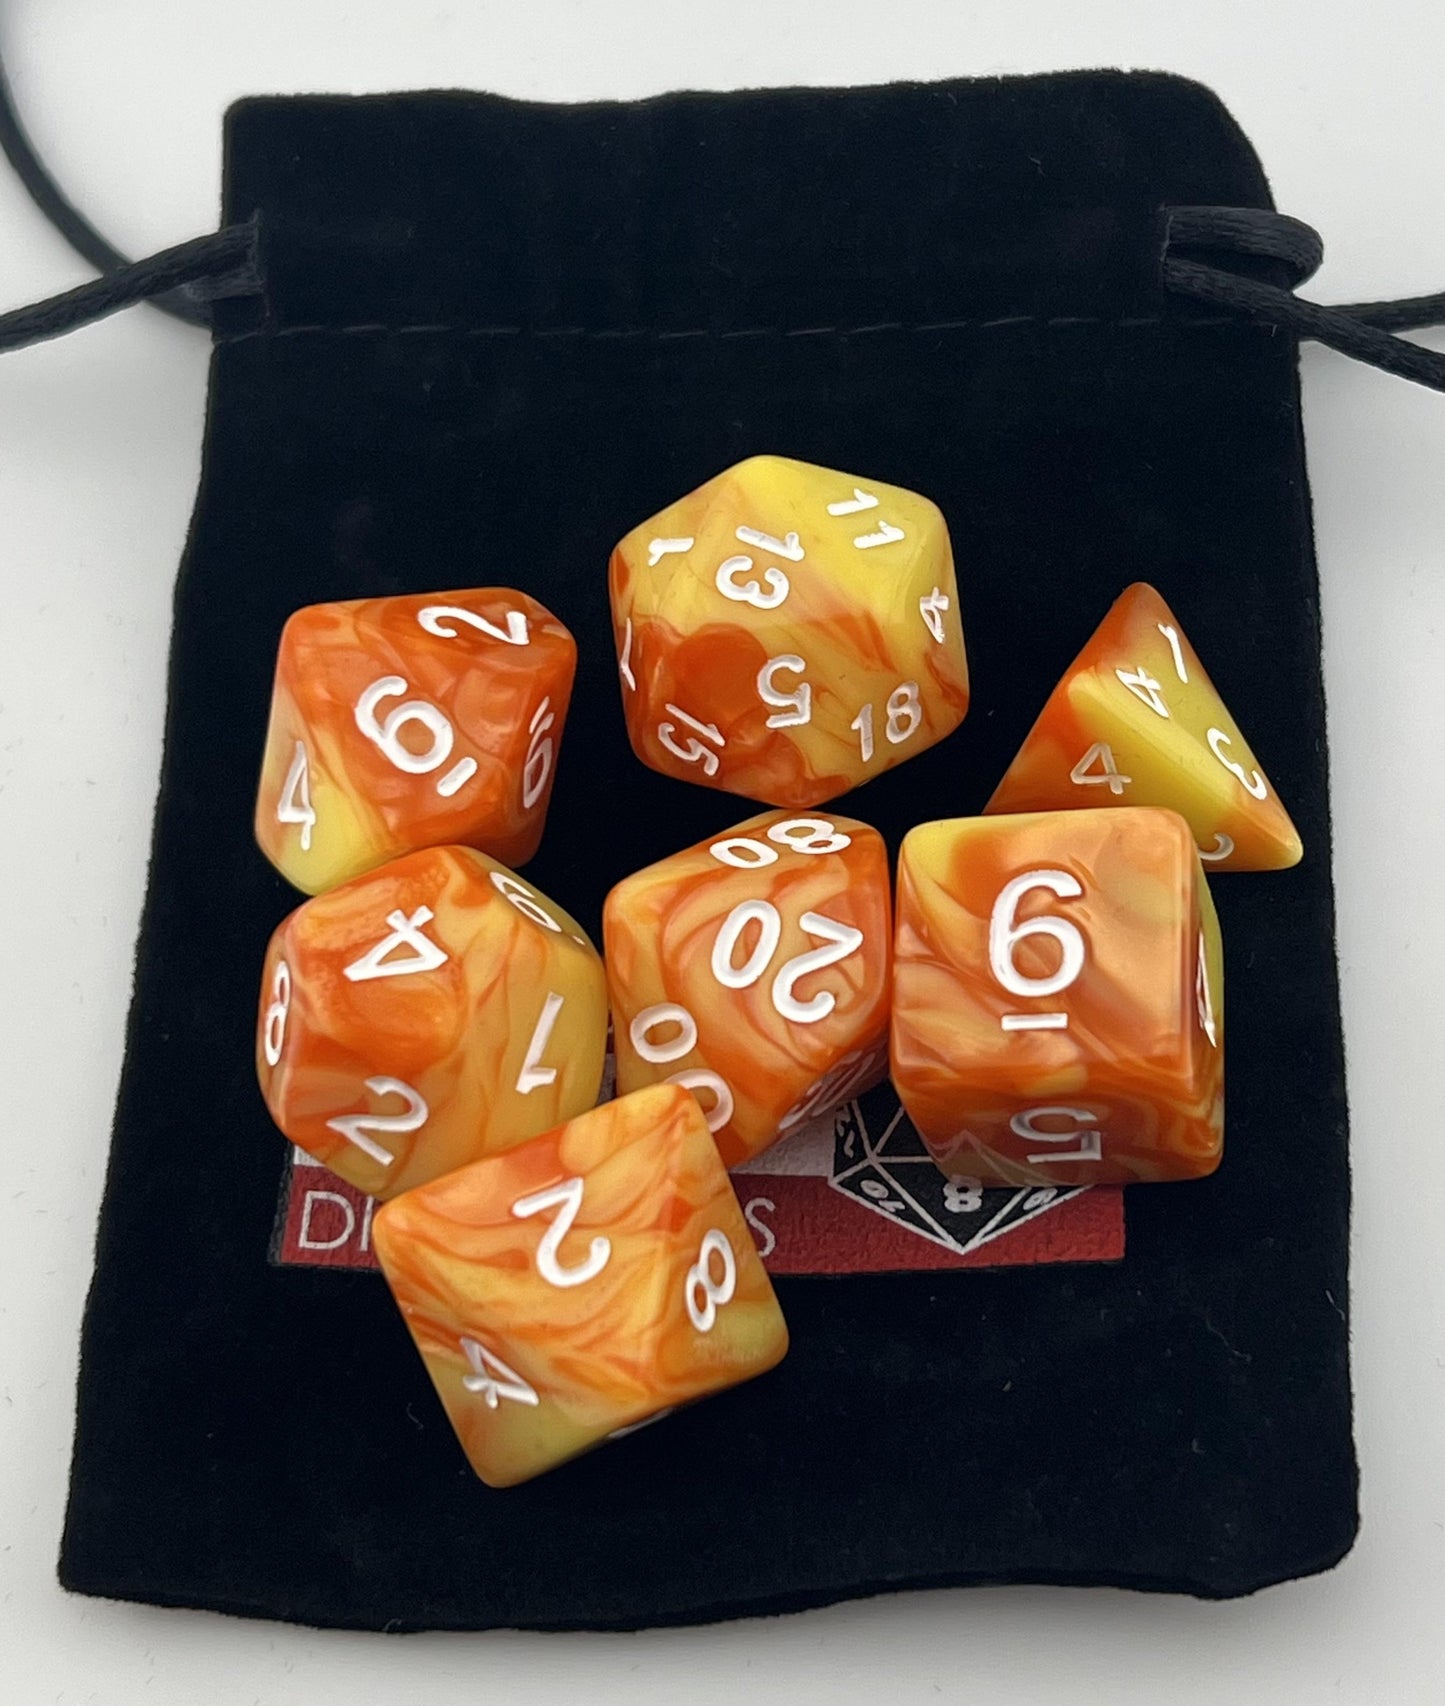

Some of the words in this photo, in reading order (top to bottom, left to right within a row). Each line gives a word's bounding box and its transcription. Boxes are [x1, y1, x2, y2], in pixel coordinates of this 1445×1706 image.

[826, 488, 905, 549] 11
[714, 525, 805, 609] 13
[418, 606, 530, 646] 2
[920, 587, 949, 643] 4
[1158, 623, 1189, 684] 1
[757, 654, 811, 728] 5
[851, 680, 922, 762] 18
[1115, 666, 1169, 718] 4
[658, 703, 725, 776] 15
[1070, 742, 1132, 794] 4
[1206, 727, 1267, 800] 3
[277, 740, 316, 851] 4
[709, 818, 851, 868] 80
[343, 905, 449, 982] 4
[711, 899, 863, 1023] 20
[264, 960, 291, 1067] 8
[515, 991, 564, 1095] 1
[326, 1075, 429, 1166] 2
[1009, 1106, 1102, 1164] 5
[513, 1177, 611, 1287] 2
[685, 1229, 736, 1332] 8
[460, 1336, 539, 1409] 4
